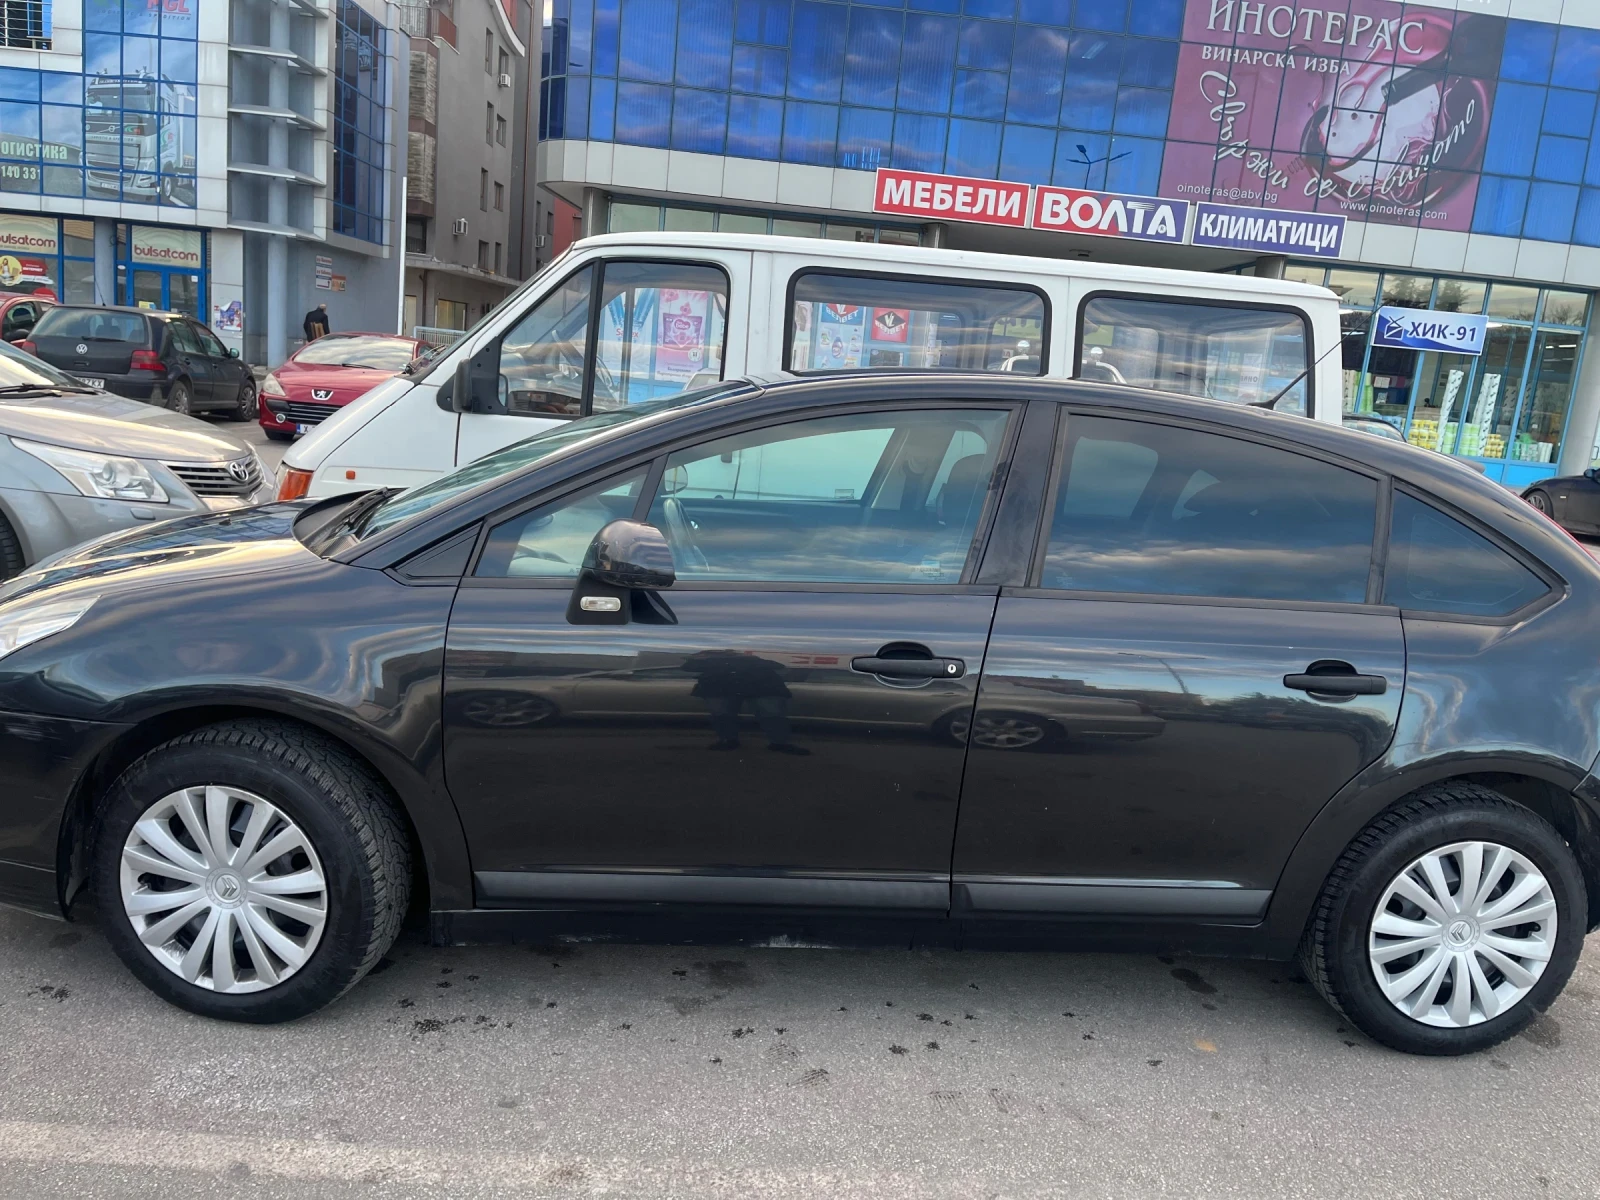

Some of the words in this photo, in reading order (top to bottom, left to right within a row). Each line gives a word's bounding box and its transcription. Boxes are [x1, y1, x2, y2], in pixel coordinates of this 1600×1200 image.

[149, 13, 191, 21] SPDITION
[1201, 45, 1296, 69] ВИНАРСКА
[1304, 57, 1351, 76] ИЗБА
[1177, 183, 1278, 204] oinoteras@abv.bg
[1303, 175, 1338, 198] се
[882, 177, 1021, 219] МЕБЕЛИ
[1040, 192, 1176, 238] ВОЛТА
[1339, 201, 1448, 220] www.oinoteras.com
[0, 233, 56, 248] ulsatcom
[1199, 213, 1339, 252] КЛИМАТИЦИ
[134, 244, 199, 261] bulsatcom
[1407, 321, 1477, 342] ХИК-91
